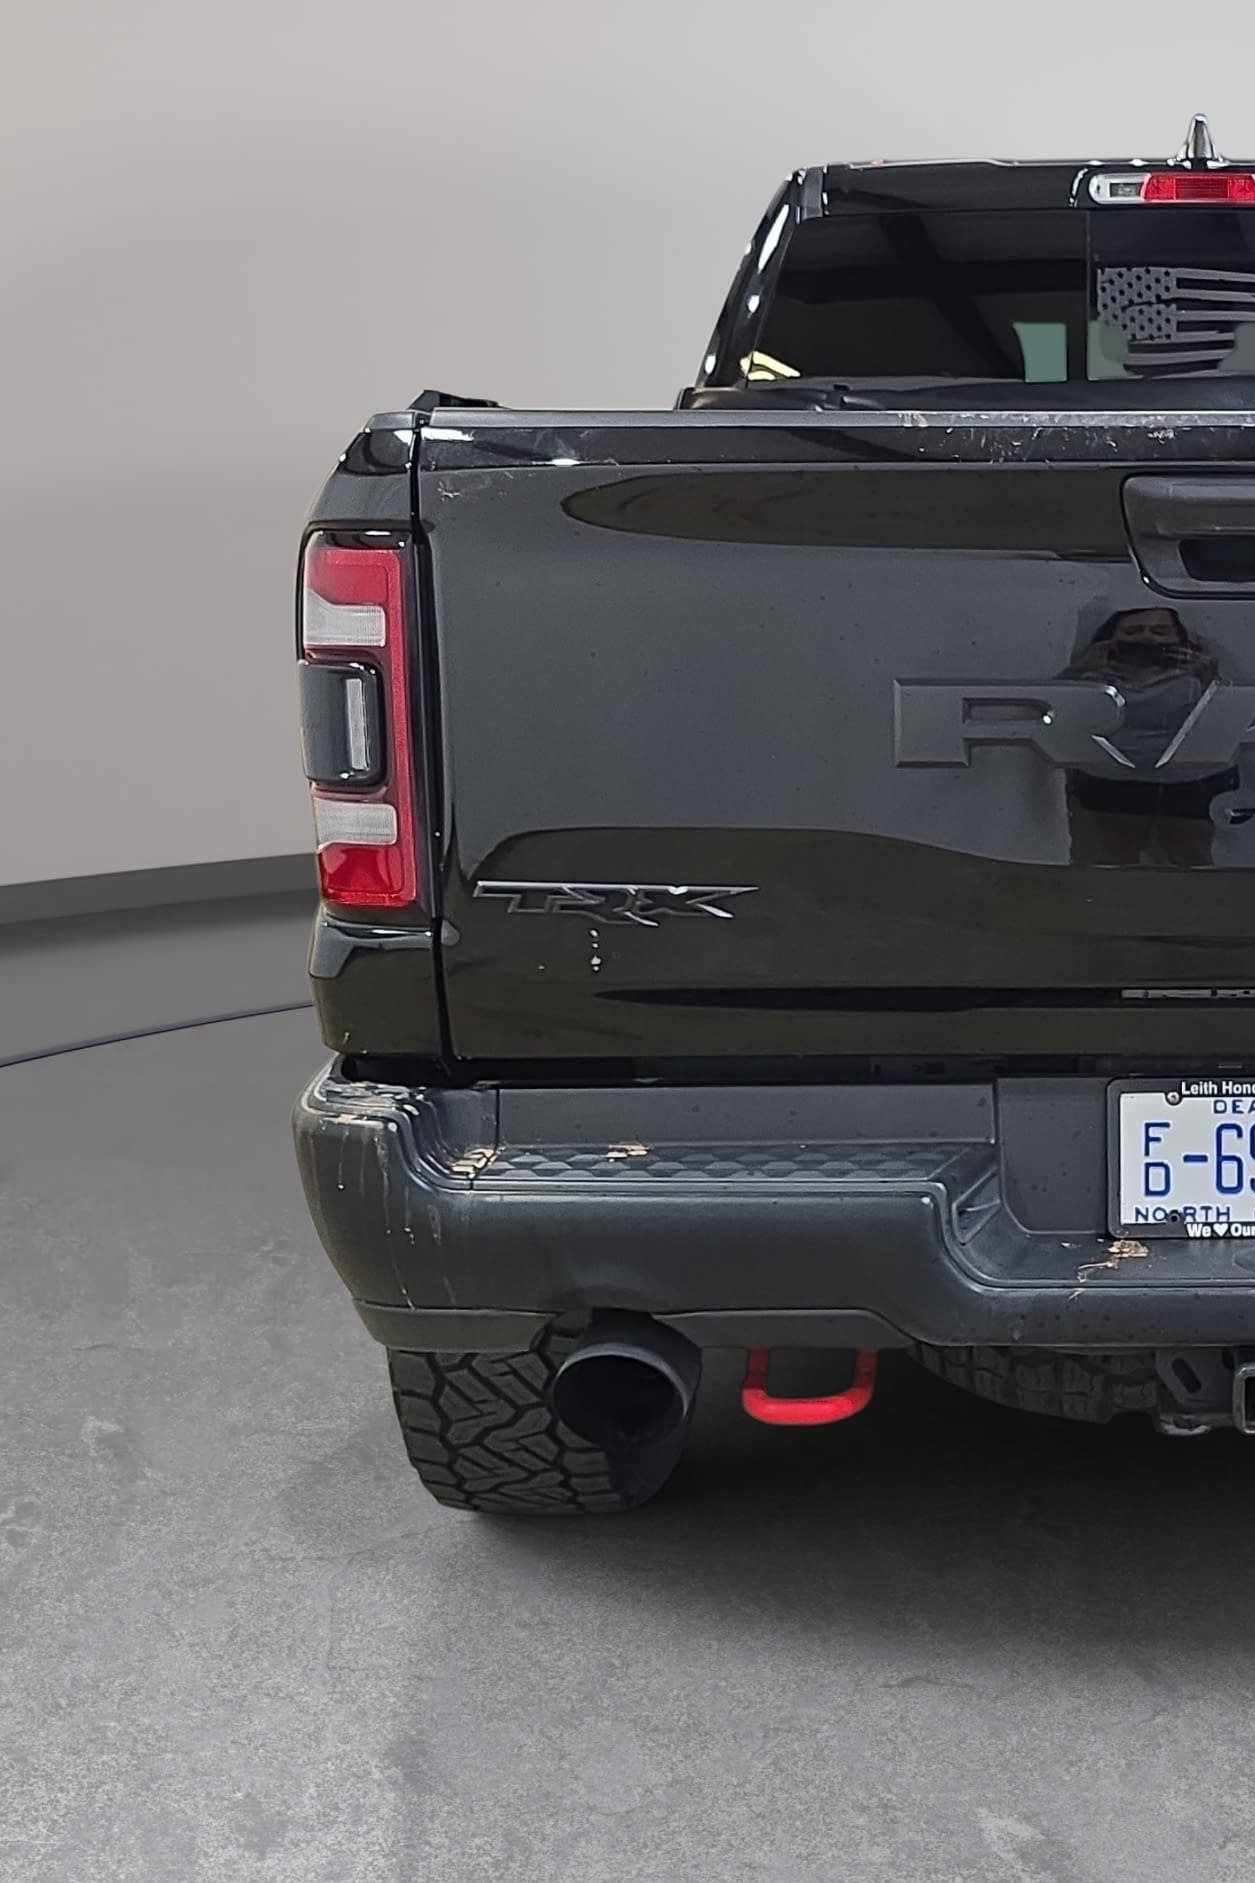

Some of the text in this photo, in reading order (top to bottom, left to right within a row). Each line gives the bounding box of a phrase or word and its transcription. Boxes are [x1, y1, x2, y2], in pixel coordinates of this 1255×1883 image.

[1181, 1081, 1217, 1095] Leith
[1135, 1205, 1231, 1222] NORTH
[1186, 1223, 1212, 1237] We
